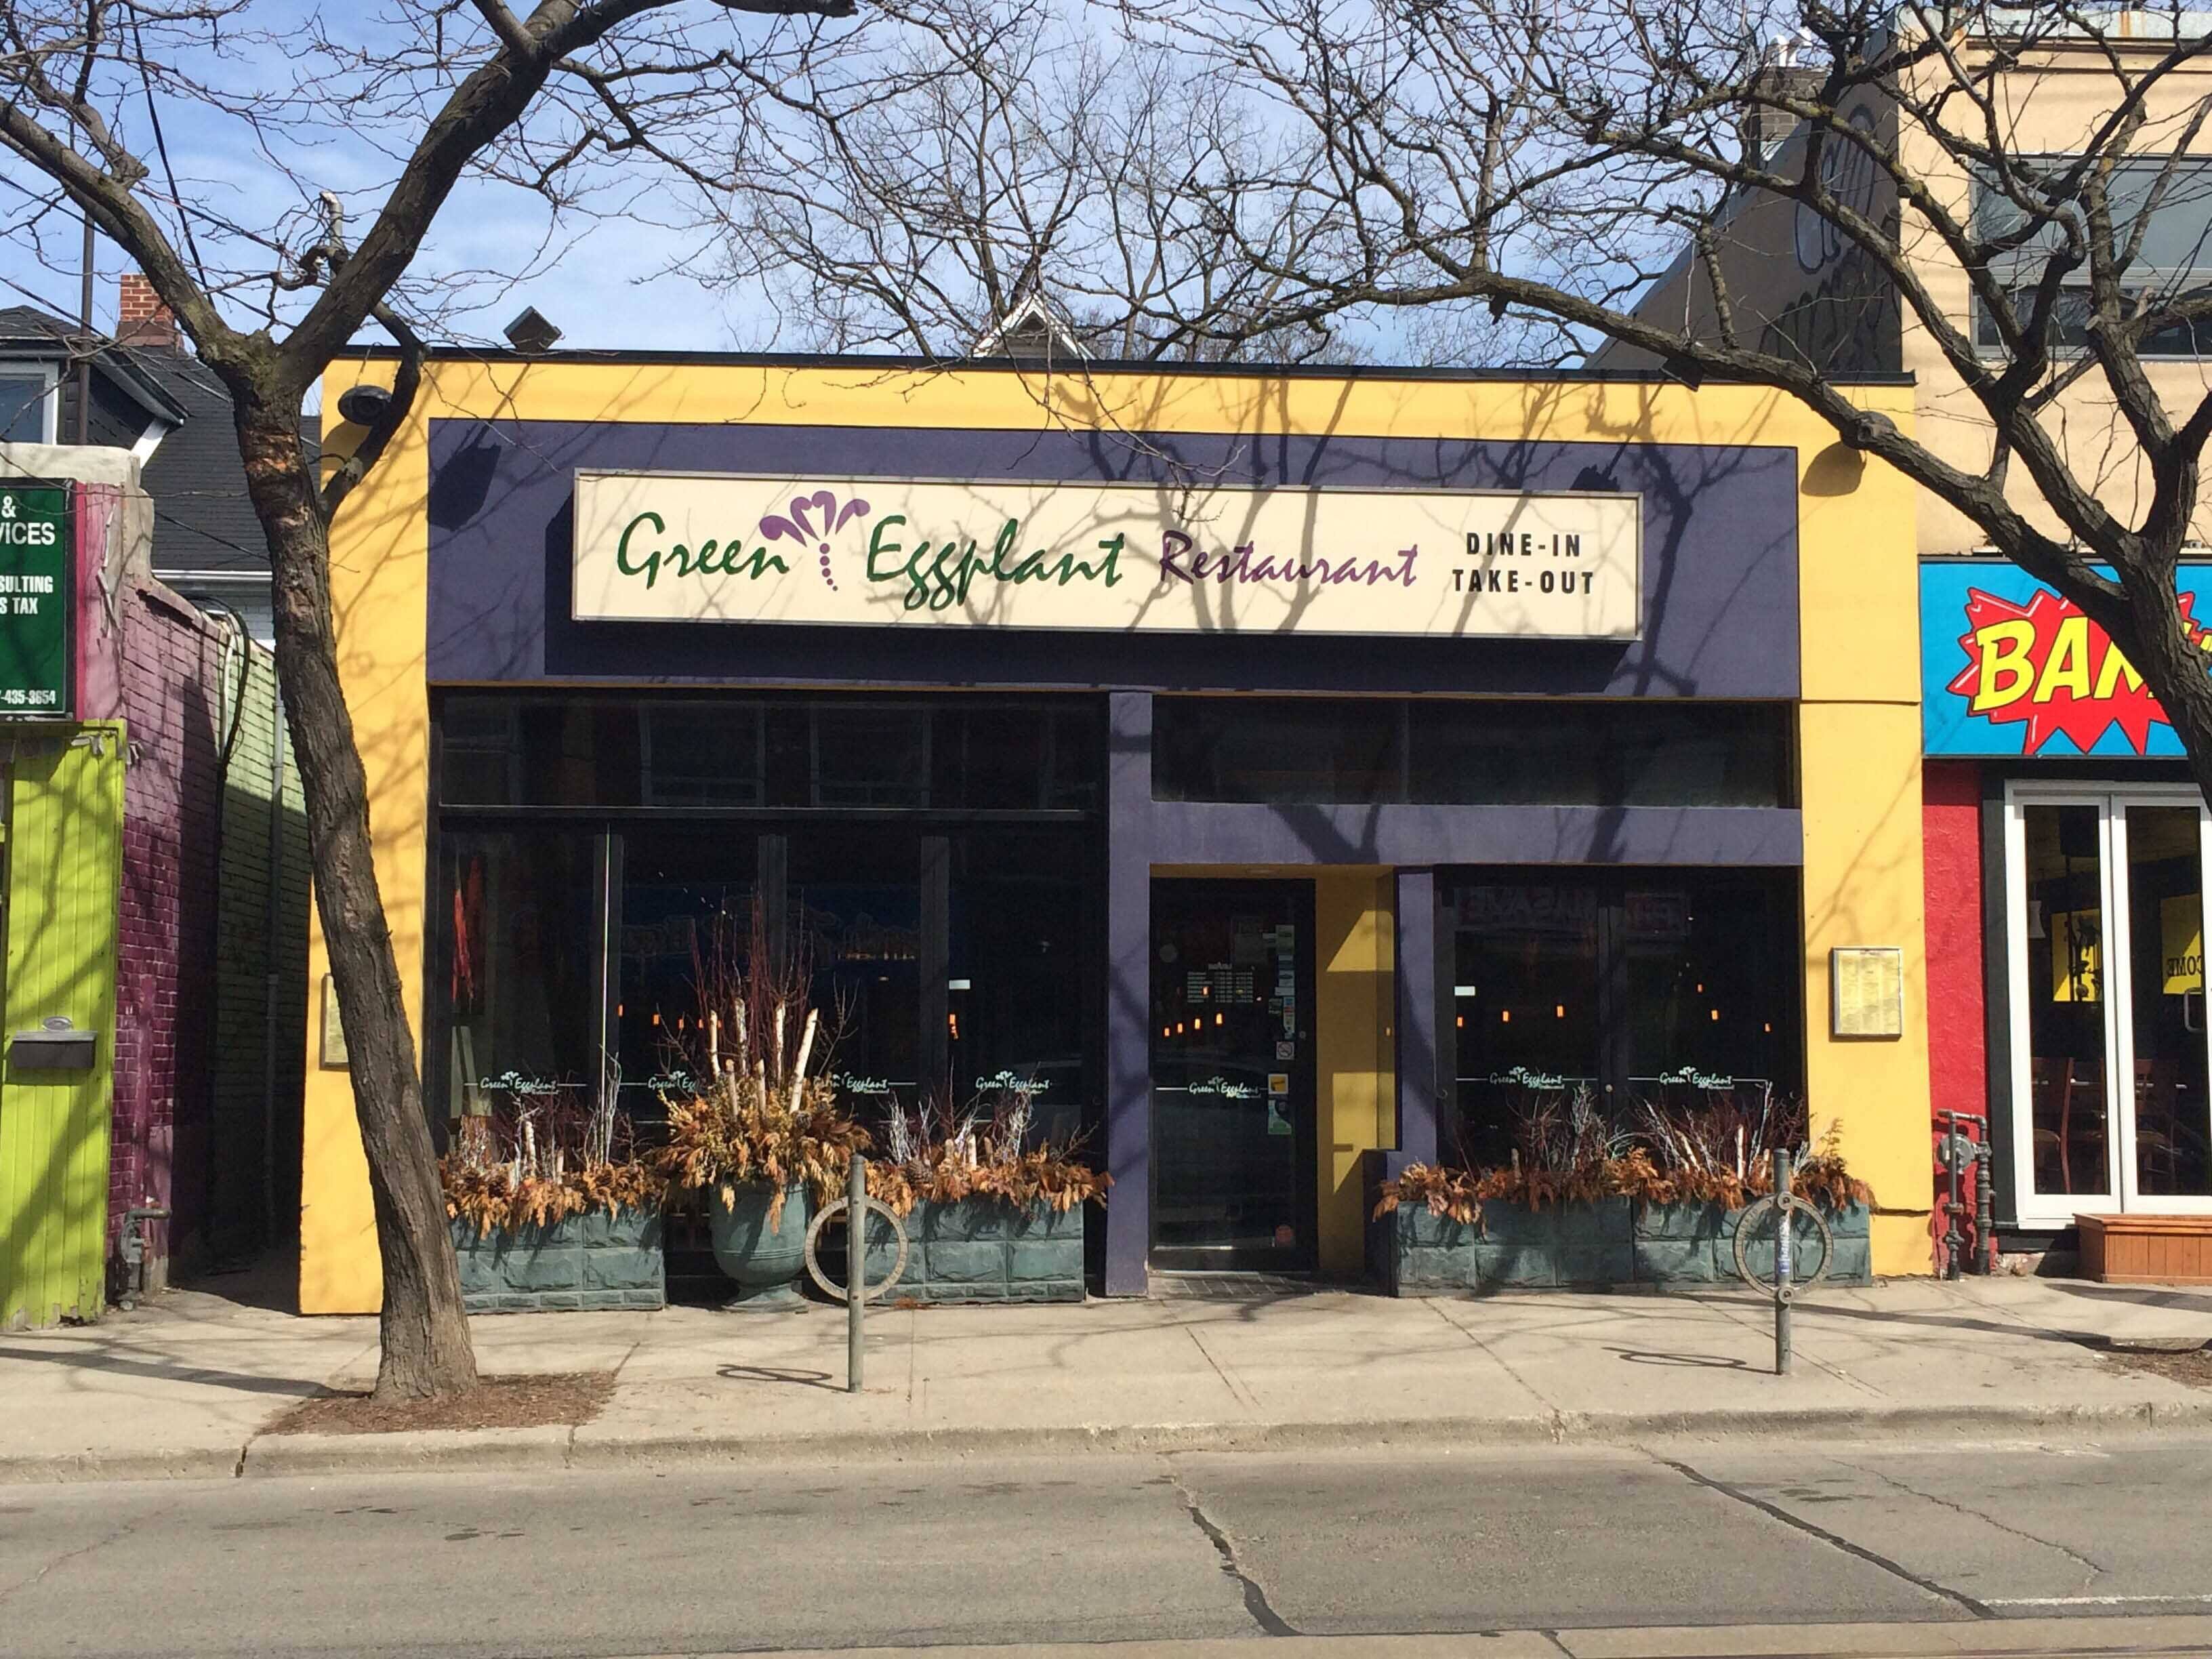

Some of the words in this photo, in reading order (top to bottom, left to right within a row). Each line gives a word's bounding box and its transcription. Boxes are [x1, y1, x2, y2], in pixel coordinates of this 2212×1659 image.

[1, 495, 16, 518] &
[1467, 532, 1580, 557] DINE-IN
[617, 511, 789, 590] Green
[867, 514, 1125, 611] Eggplant
[1160, 530, 1418, 587] Restaurant
[1452, 568, 1594, 595] TAKE-OUT
[12, 597, 39, 615] TAX
[0, 689, 56, 705] -435-3654
